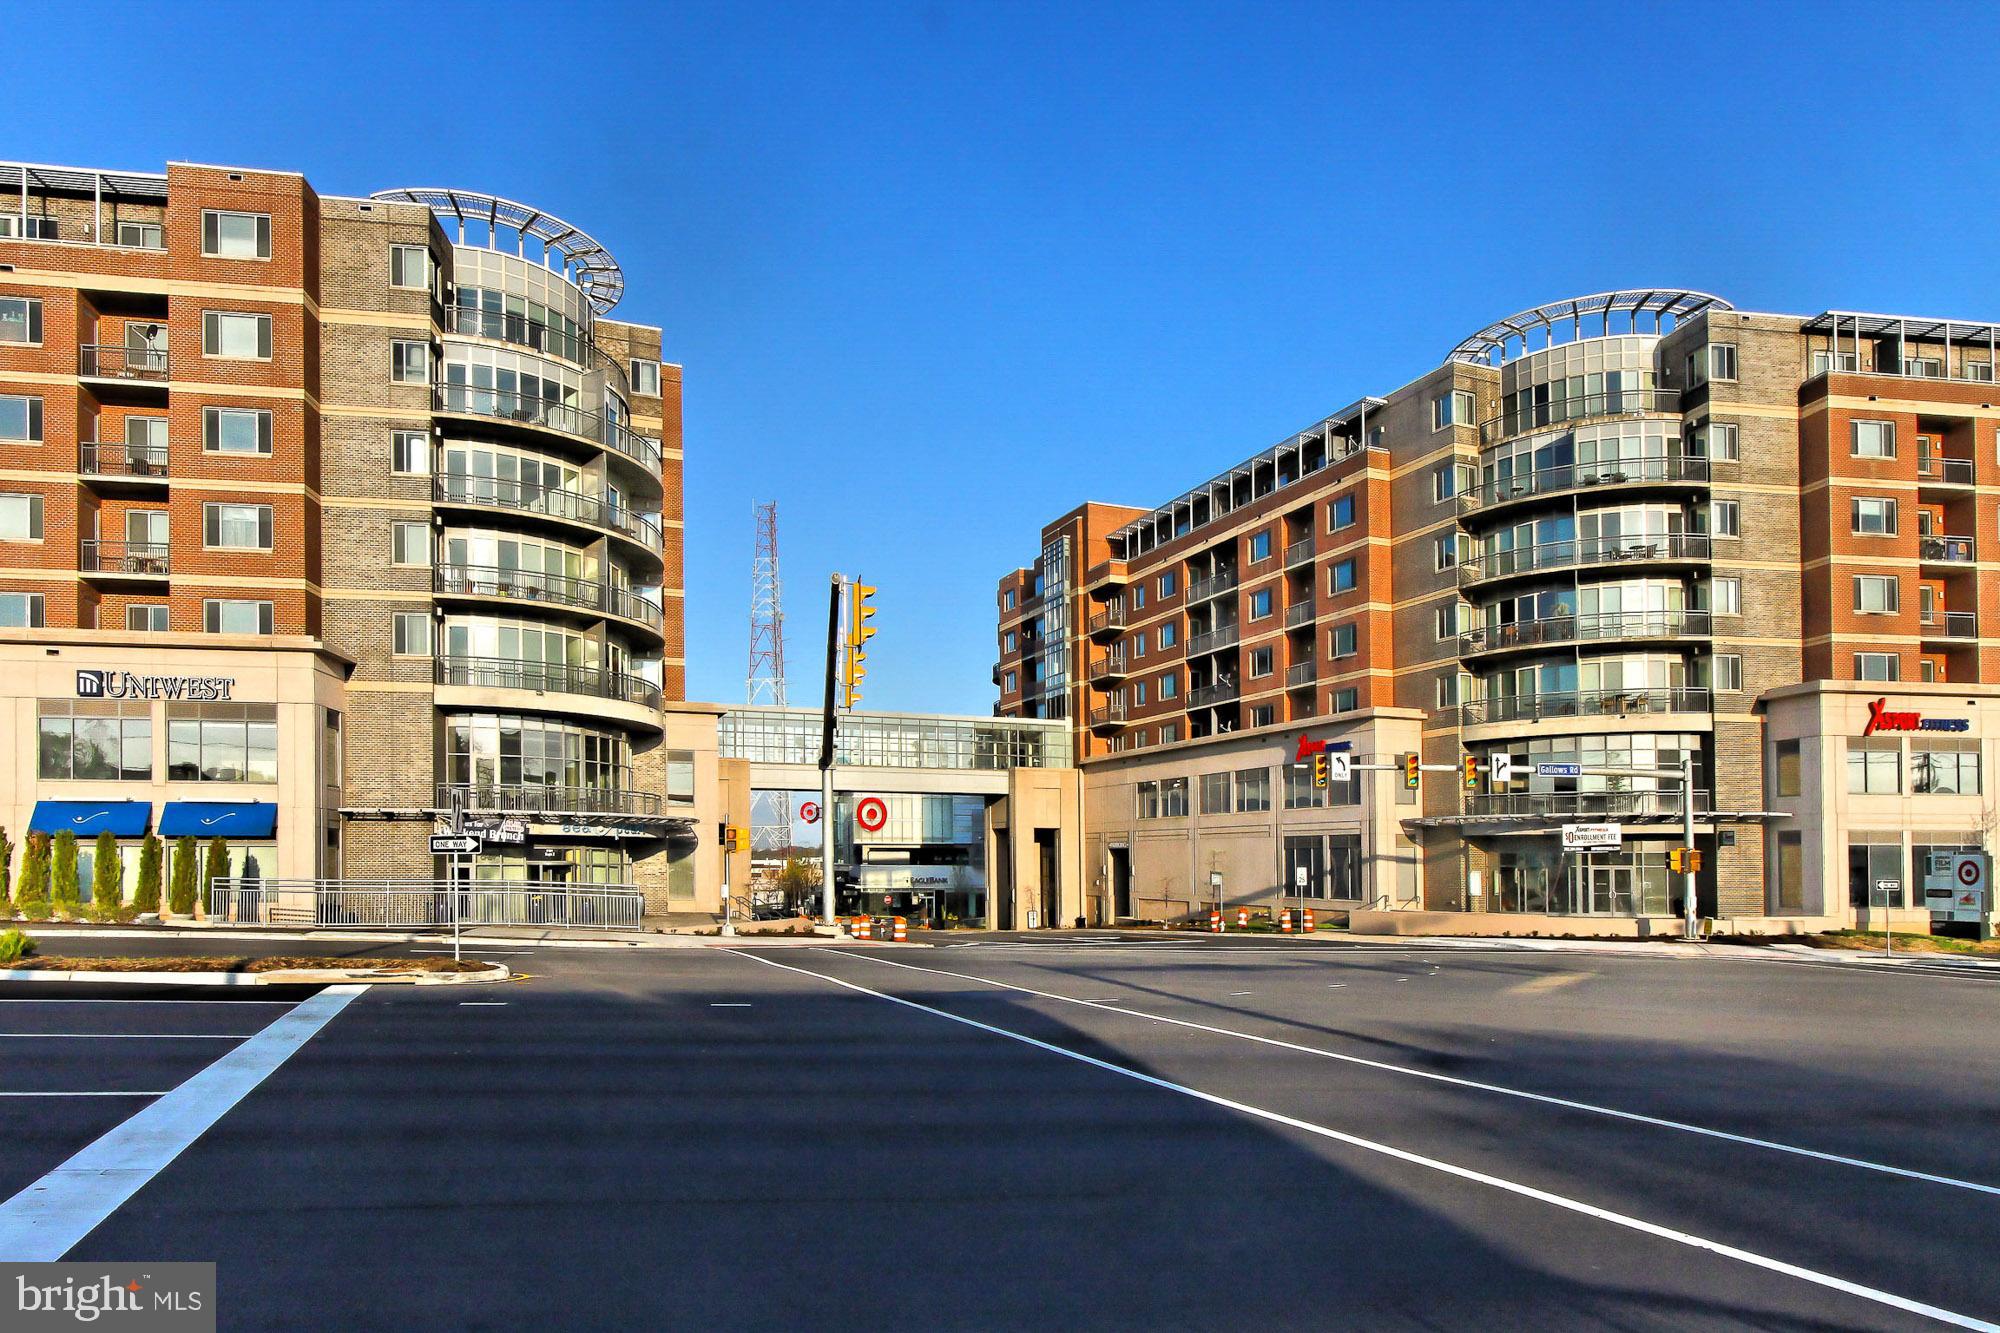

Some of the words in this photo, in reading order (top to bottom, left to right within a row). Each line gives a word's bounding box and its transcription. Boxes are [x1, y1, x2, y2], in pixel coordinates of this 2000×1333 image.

[104, 671, 235, 700] UNIWEST
[1540, 765, 1568, 774] Gallows
[1569, 766, 1579, 774] Rd
